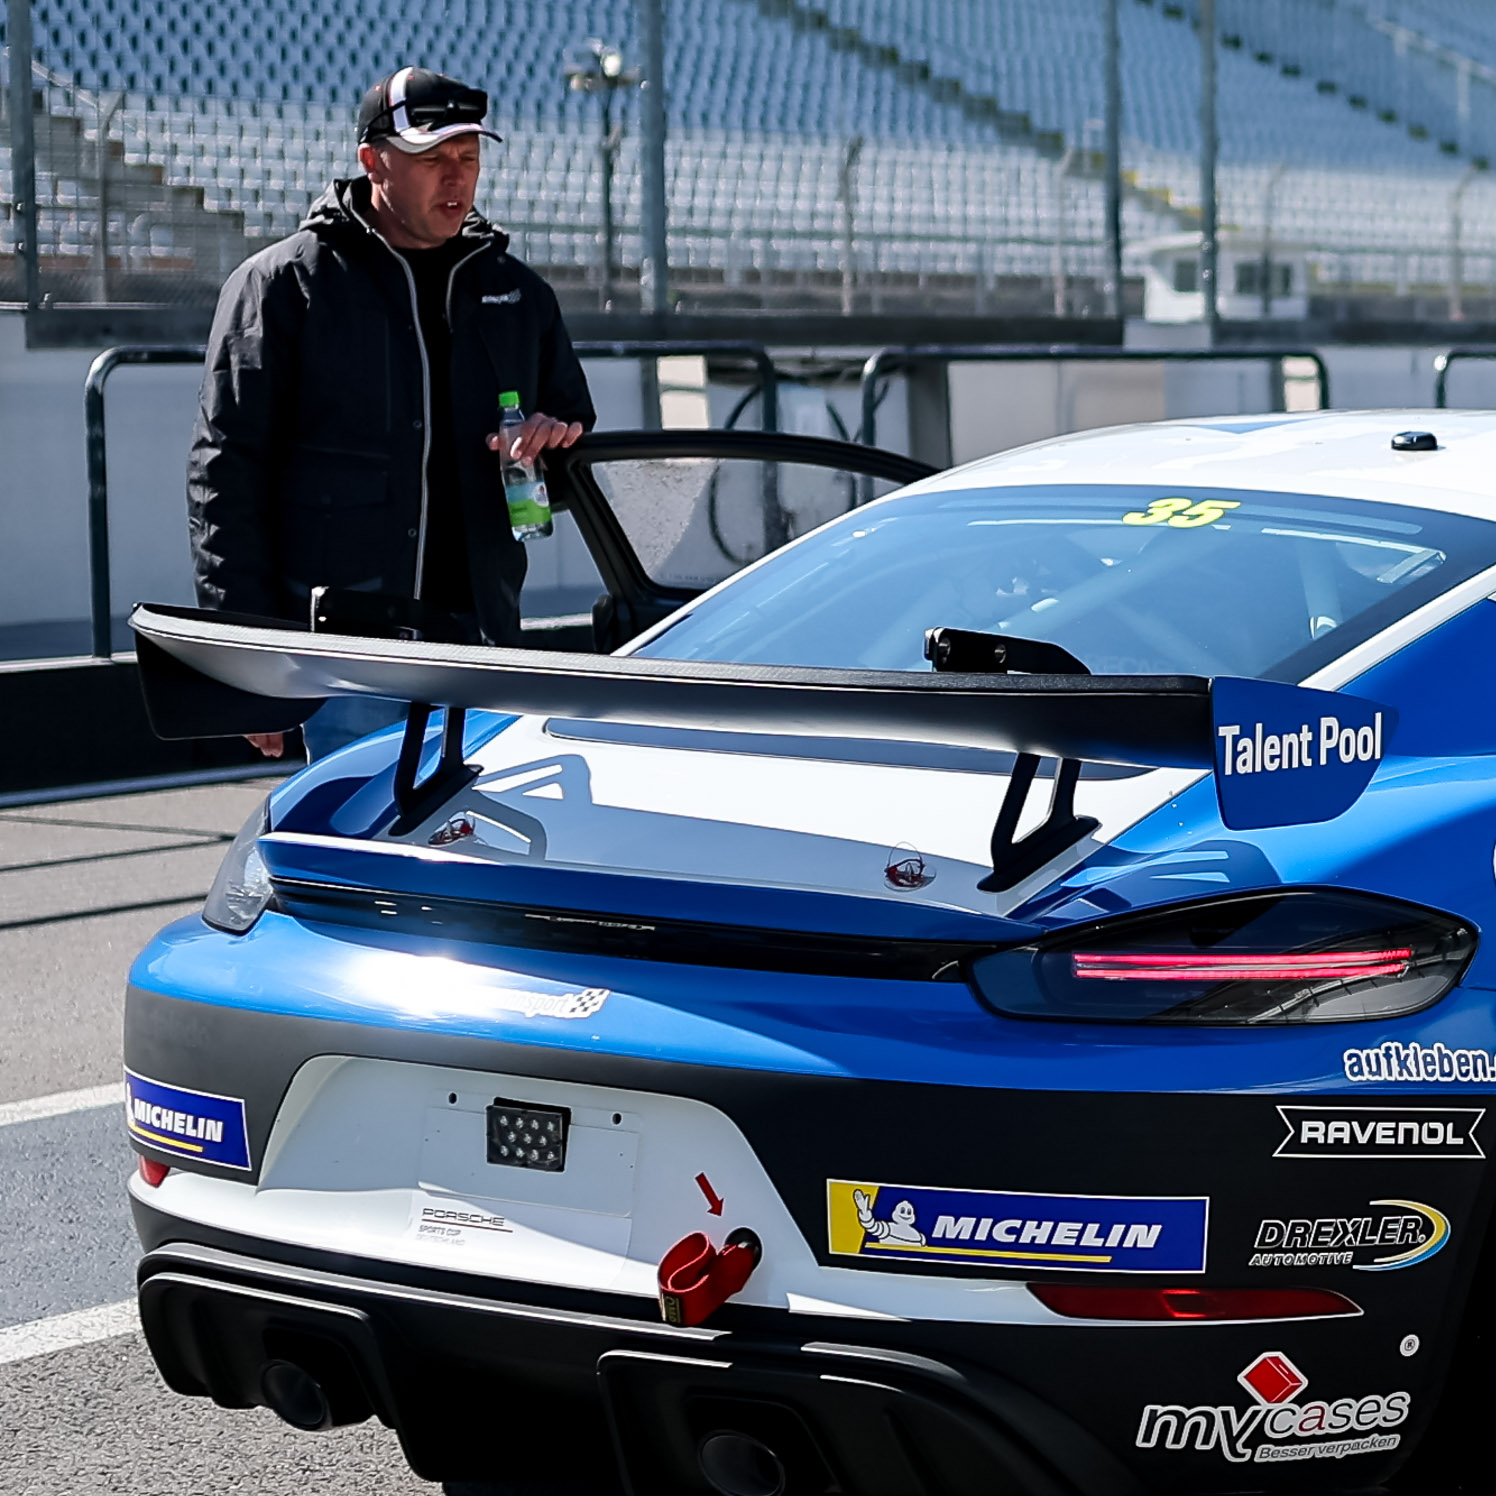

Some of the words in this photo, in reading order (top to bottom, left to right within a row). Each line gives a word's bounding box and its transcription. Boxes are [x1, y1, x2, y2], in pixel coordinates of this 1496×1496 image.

[1122, 497, 1241, 529] 35
[1217, 721, 1313, 776] Talent
[1319, 712, 1383, 766] Pool
[133, 1098, 224, 1142] MICHELIN
[1300, 1120, 1465, 1145] RAVENOL
[422, 1208, 505, 1226] PORSCHE
[931, 1215, 1163, 1249] MICHELIN
[1254, 1215, 1424, 1249] DREXLER
[1248, 1251, 1354, 1267] AUTOMOTIVE
[1136, 1391, 1411, 1463] mycases
[1258, 1443, 1315, 1460] Besser
[1318, 1434, 1398, 1457] verpacken
